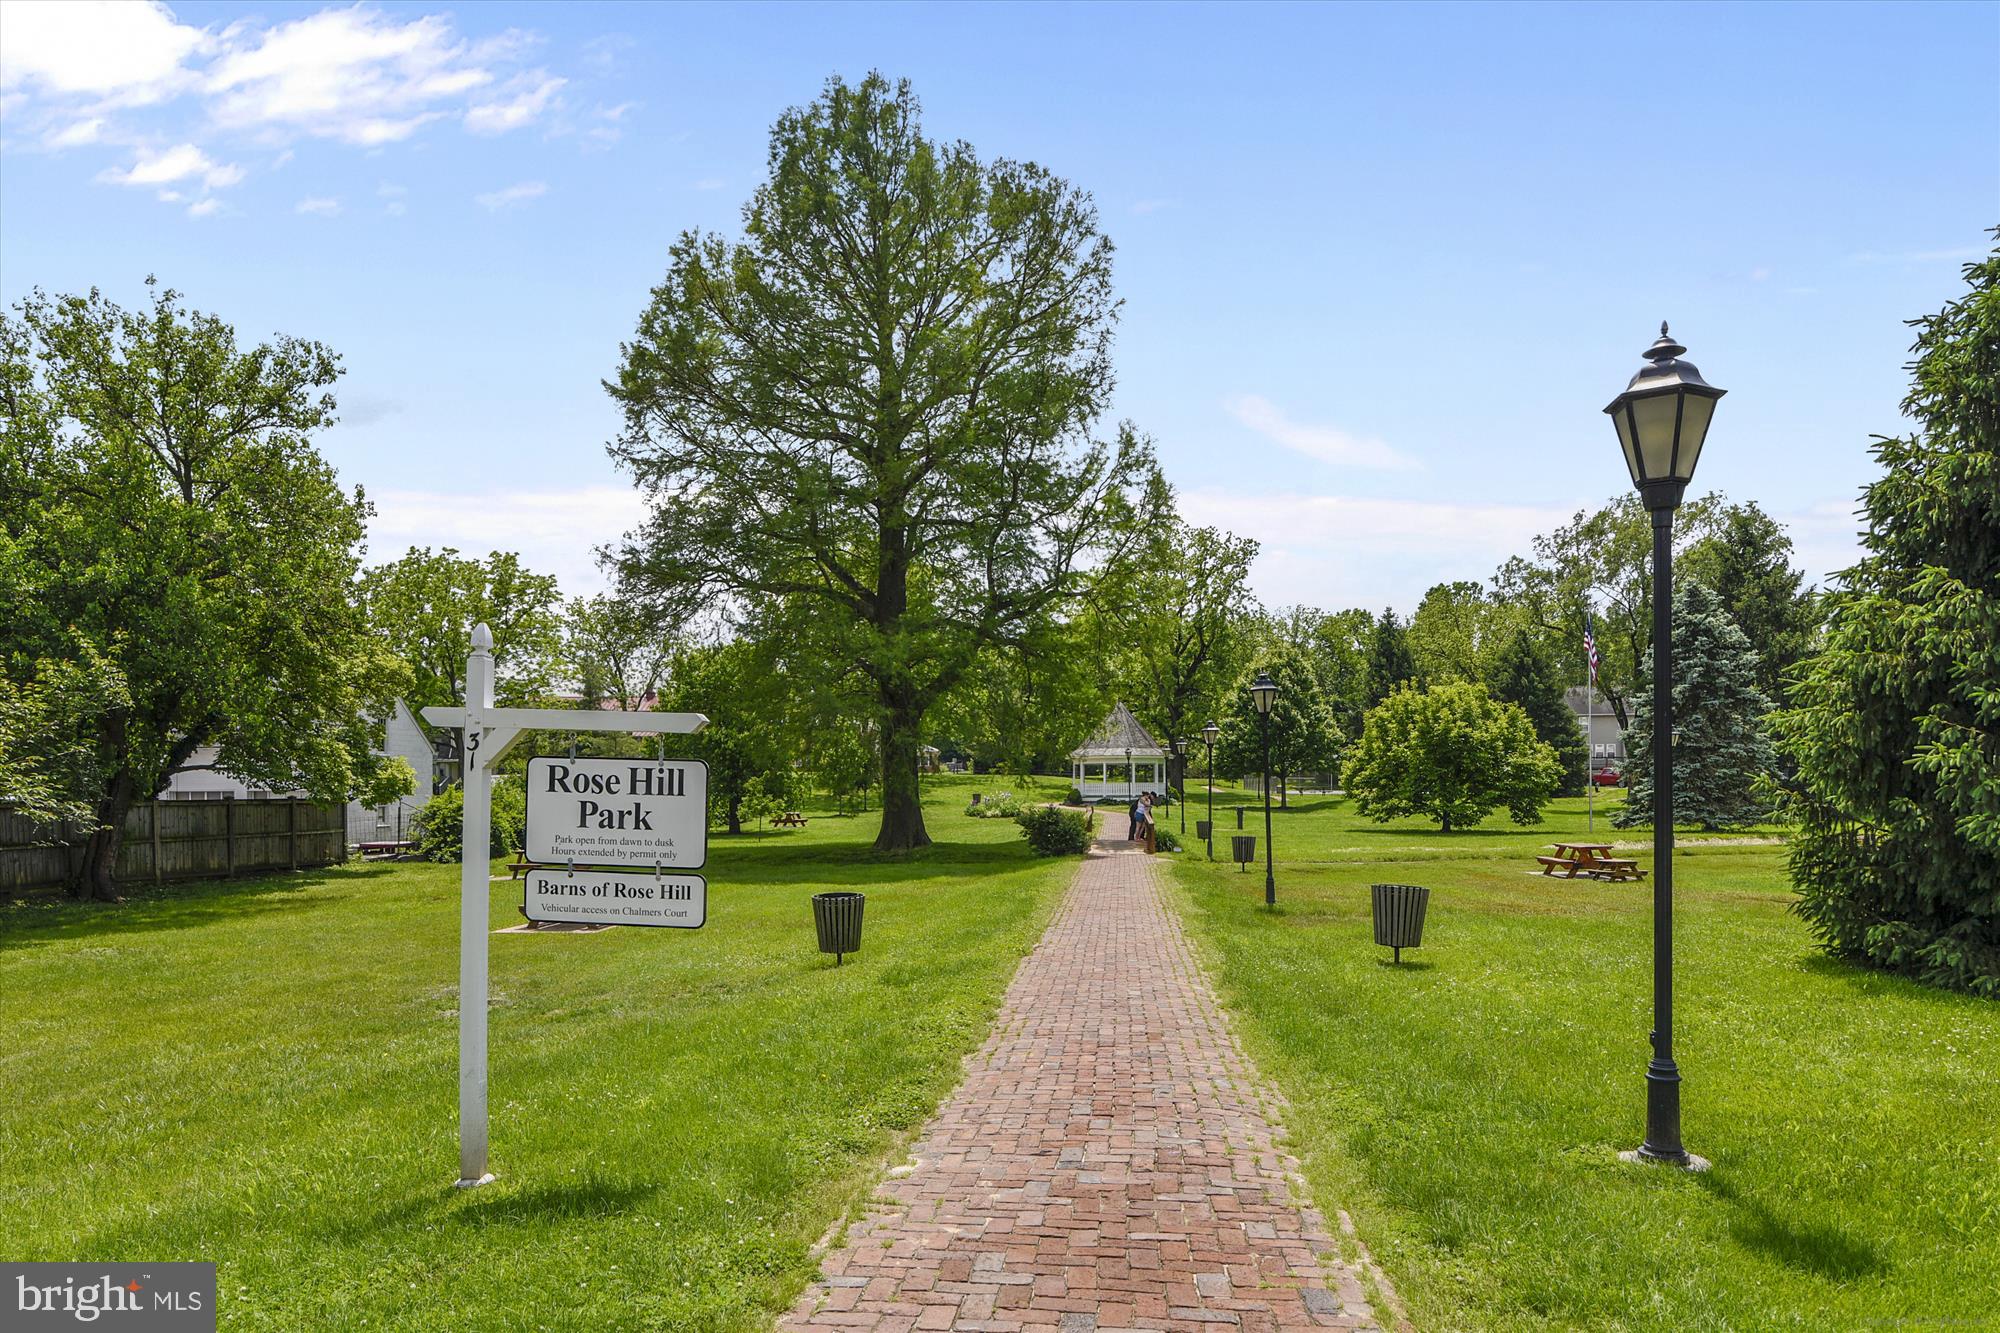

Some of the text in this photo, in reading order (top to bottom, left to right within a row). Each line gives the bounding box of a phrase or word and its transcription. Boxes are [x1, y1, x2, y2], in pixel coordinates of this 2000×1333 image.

[546, 764, 686, 797] Rose Hill
[576, 800, 653, 830] Park
[554, 835, 674, 847] Park open from dawn to dusk
[551, 846, 677, 860] Hours extended by permit only
[537, 879, 691, 900] Barns of Rose Hill
[541, 903, 688, 918] Vehicular access on Chalmers Court
